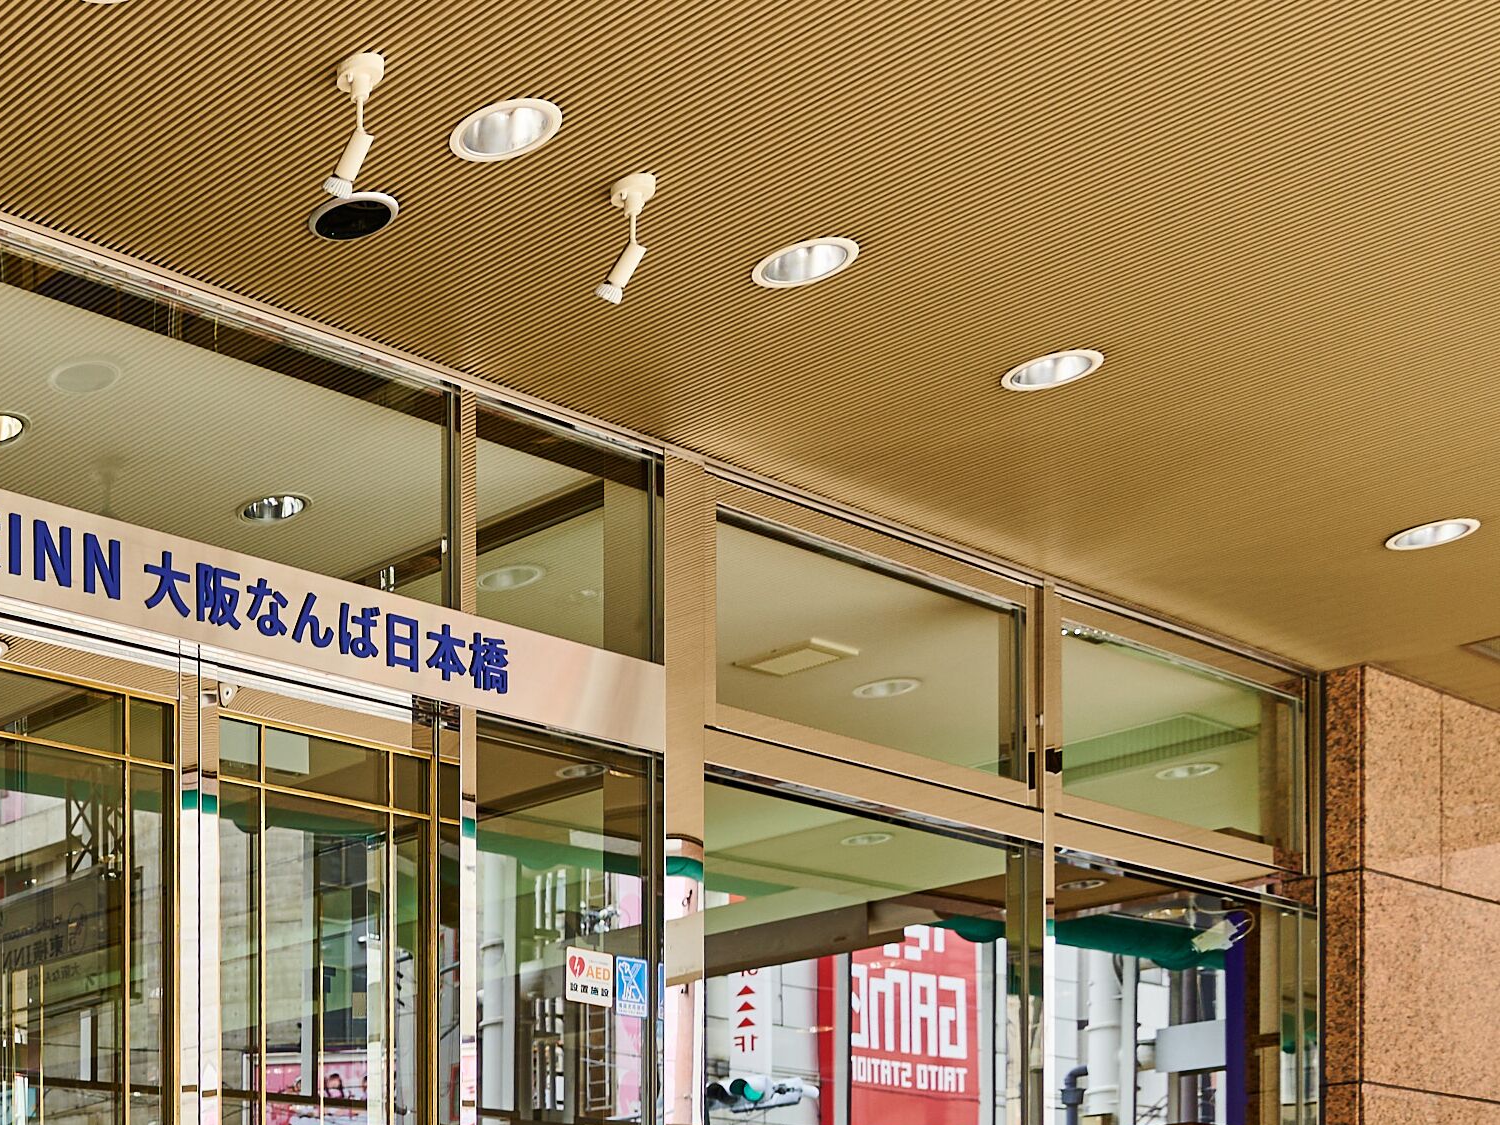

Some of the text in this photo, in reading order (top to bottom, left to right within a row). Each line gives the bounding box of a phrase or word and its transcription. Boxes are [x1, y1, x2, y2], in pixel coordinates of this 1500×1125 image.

[144, 550, 508, 694] 大阪なんば日本橋
[586, 965, 610, 981] AED
